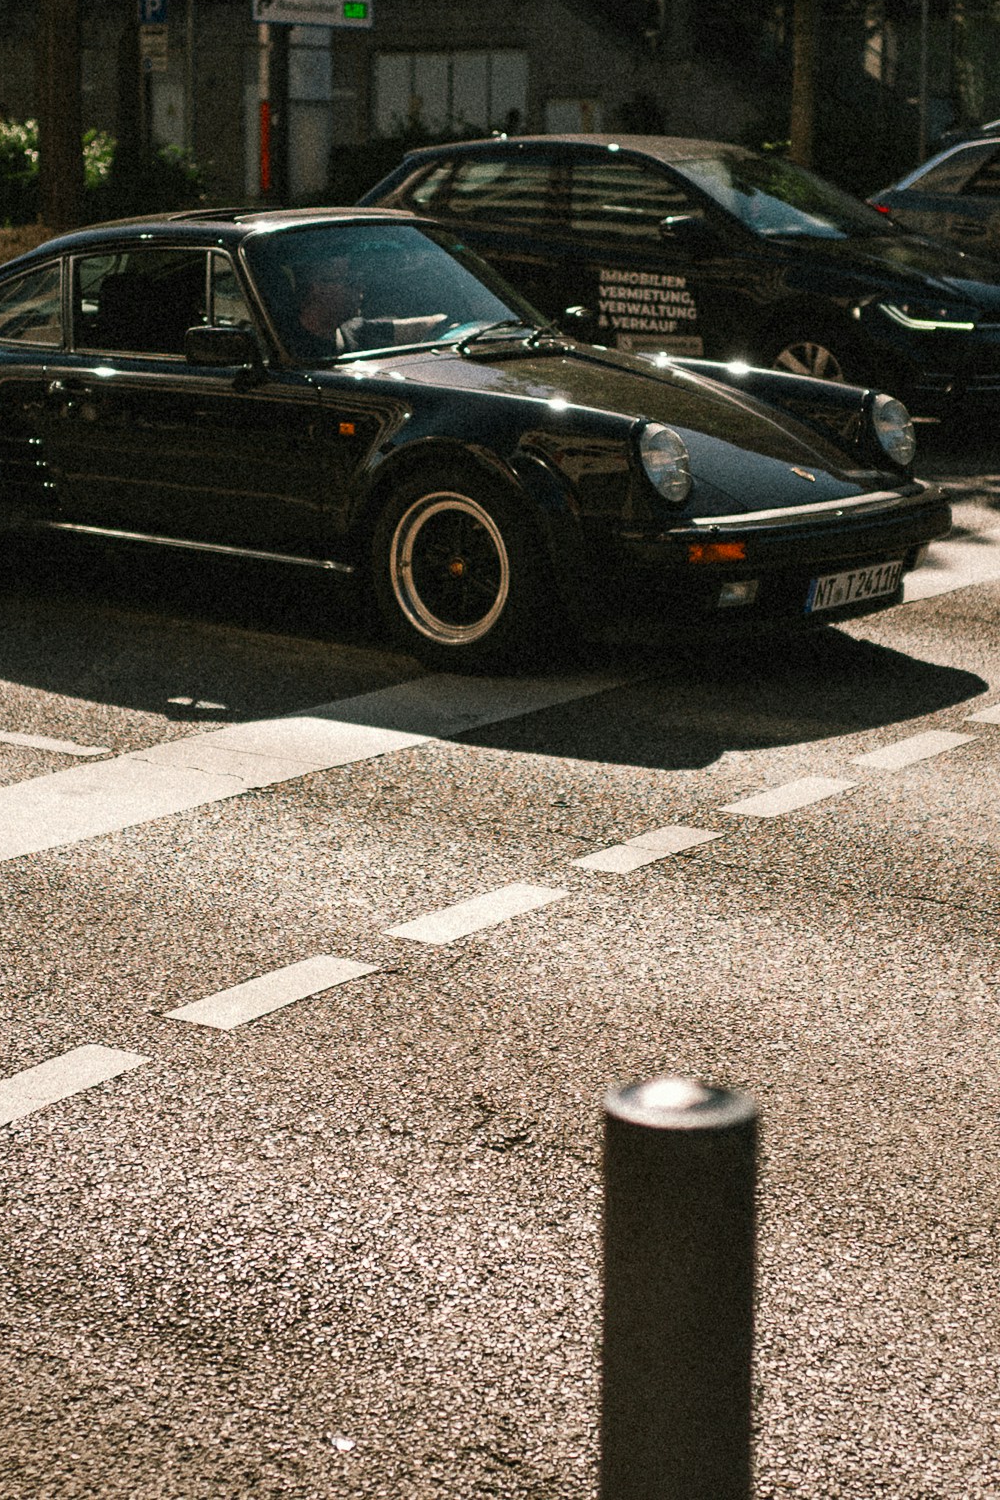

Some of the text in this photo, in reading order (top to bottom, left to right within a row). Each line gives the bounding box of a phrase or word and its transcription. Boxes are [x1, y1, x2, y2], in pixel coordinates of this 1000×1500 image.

[600, 269, 687, 288] IMMOBILIEN
[599, 285, 696, 306] VERMIETUNG,
[598, 300, 697, 320] VERWALTUNG
[598, 315, 678, 333] & VERKAUF
